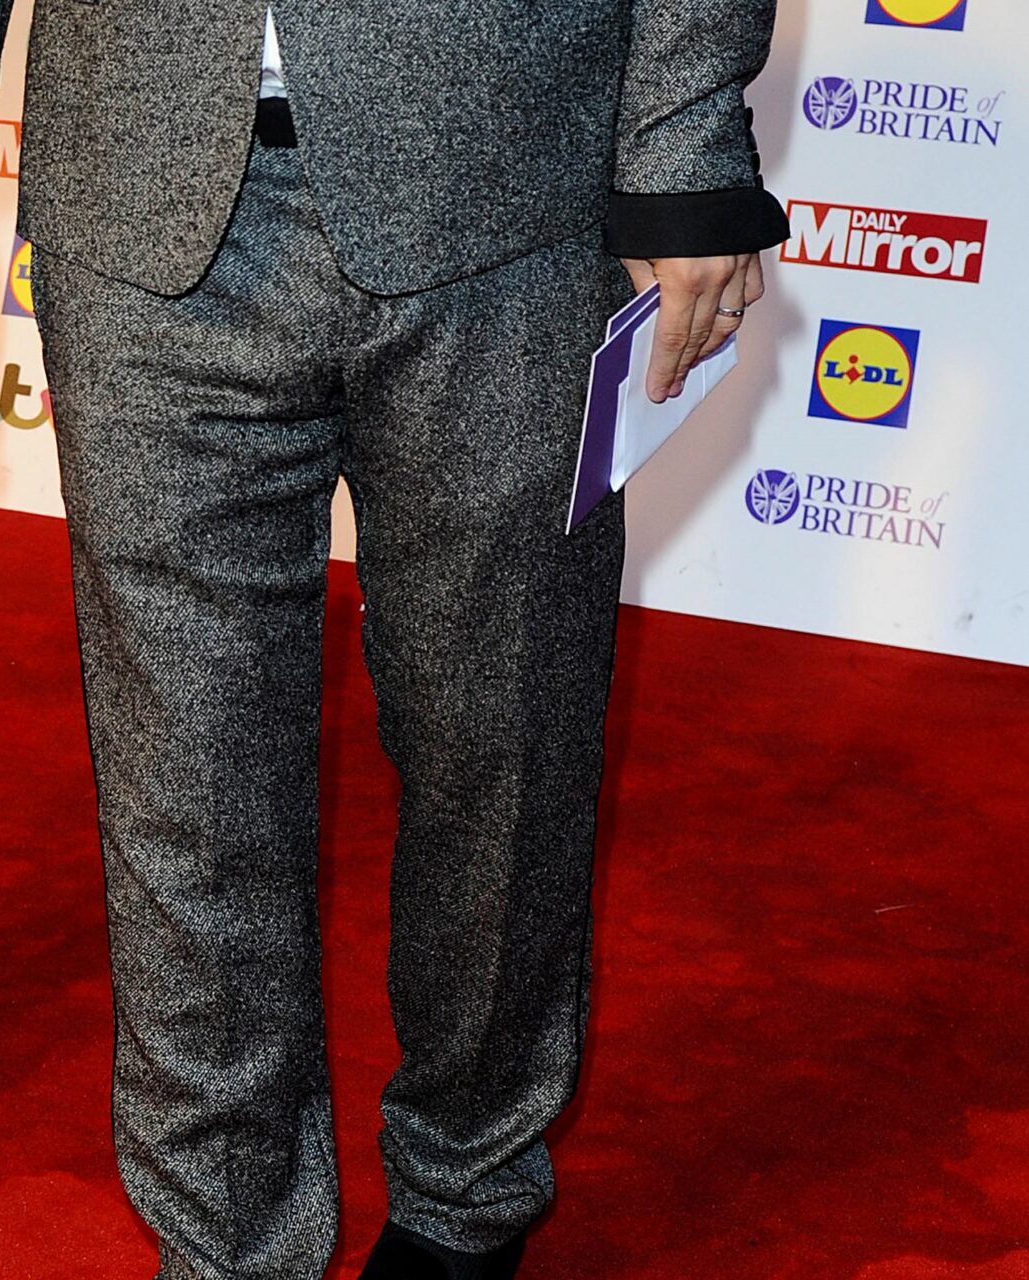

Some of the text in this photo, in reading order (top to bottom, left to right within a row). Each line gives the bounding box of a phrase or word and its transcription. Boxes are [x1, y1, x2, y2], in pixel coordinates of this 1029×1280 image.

[860, 79, 1007, 119] PRIDE of
[856, 108, 1002, 147] BRITAIN
[784, 204, 982, 278] Mirror
[851, 210, 908, 232] DAILY
[804, 474, 950, 519] PRIDE of
[798, 504, 946, 549] BRITAIN
